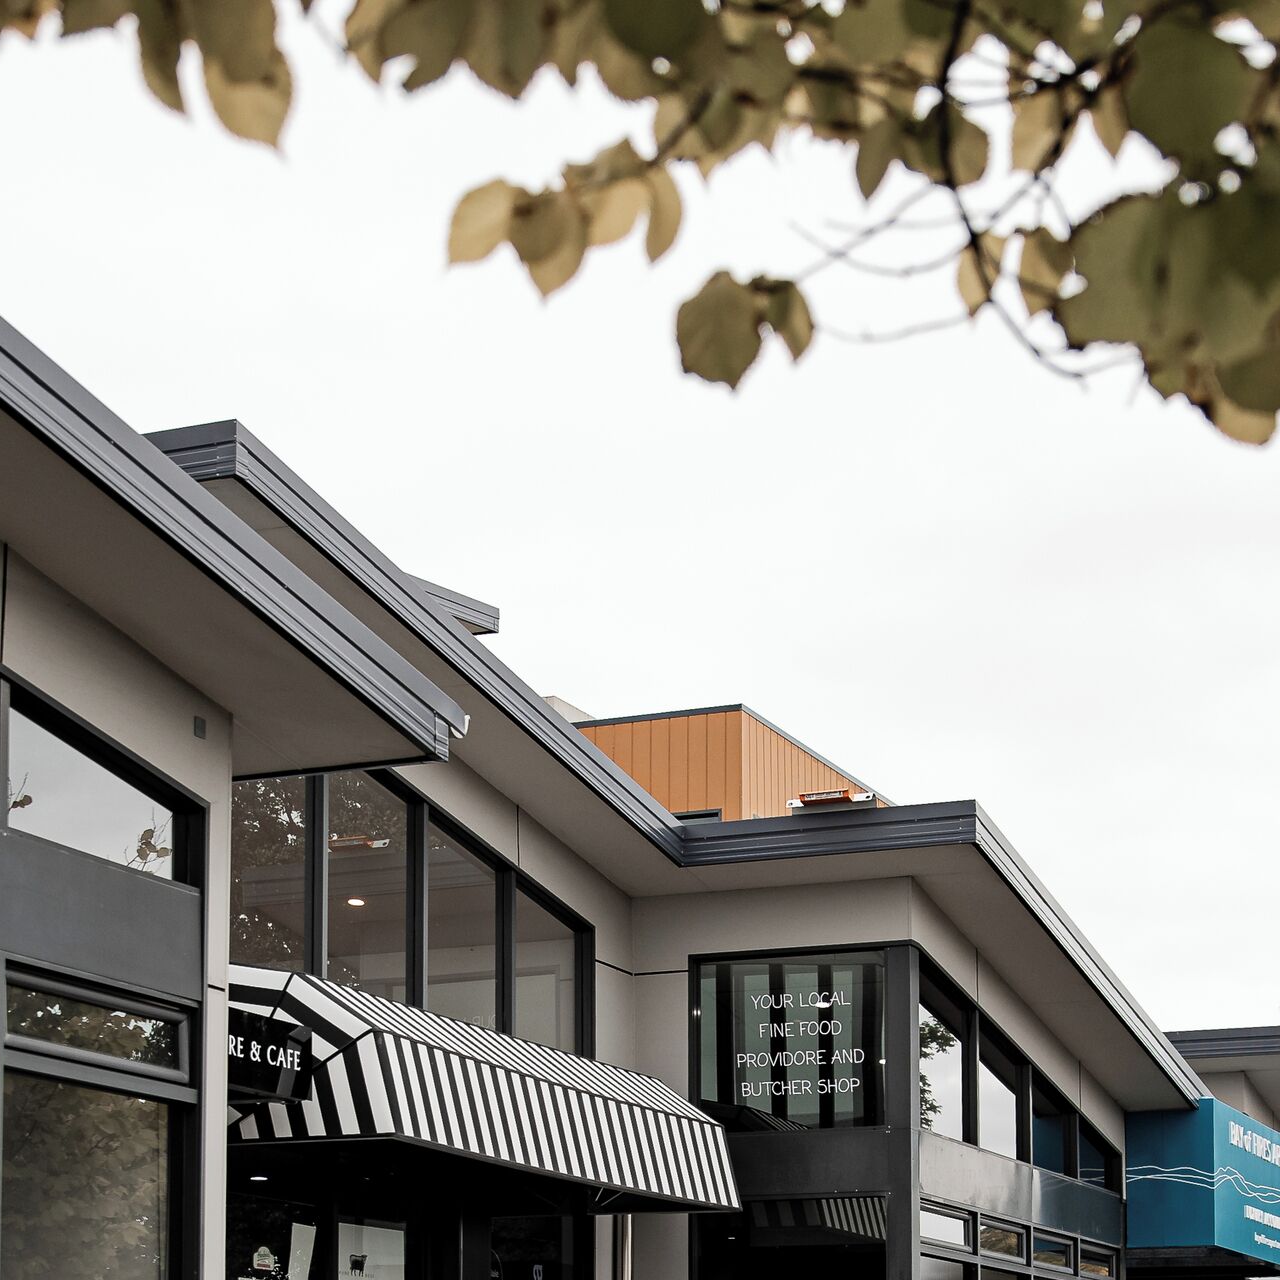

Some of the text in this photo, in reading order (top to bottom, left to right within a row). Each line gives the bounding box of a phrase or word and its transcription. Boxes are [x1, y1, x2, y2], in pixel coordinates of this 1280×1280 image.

[751, 990, 851, 1010] YOUR LOCAL
[759, 1020, 842, 1038] FINE FOOD
[228, 1034, 301, 1071] RE & CAFE
[737, 1048, 865, 1068] PROVIDORE AND
[741, 1078, 860, 1097] BUTCHER SHOP
